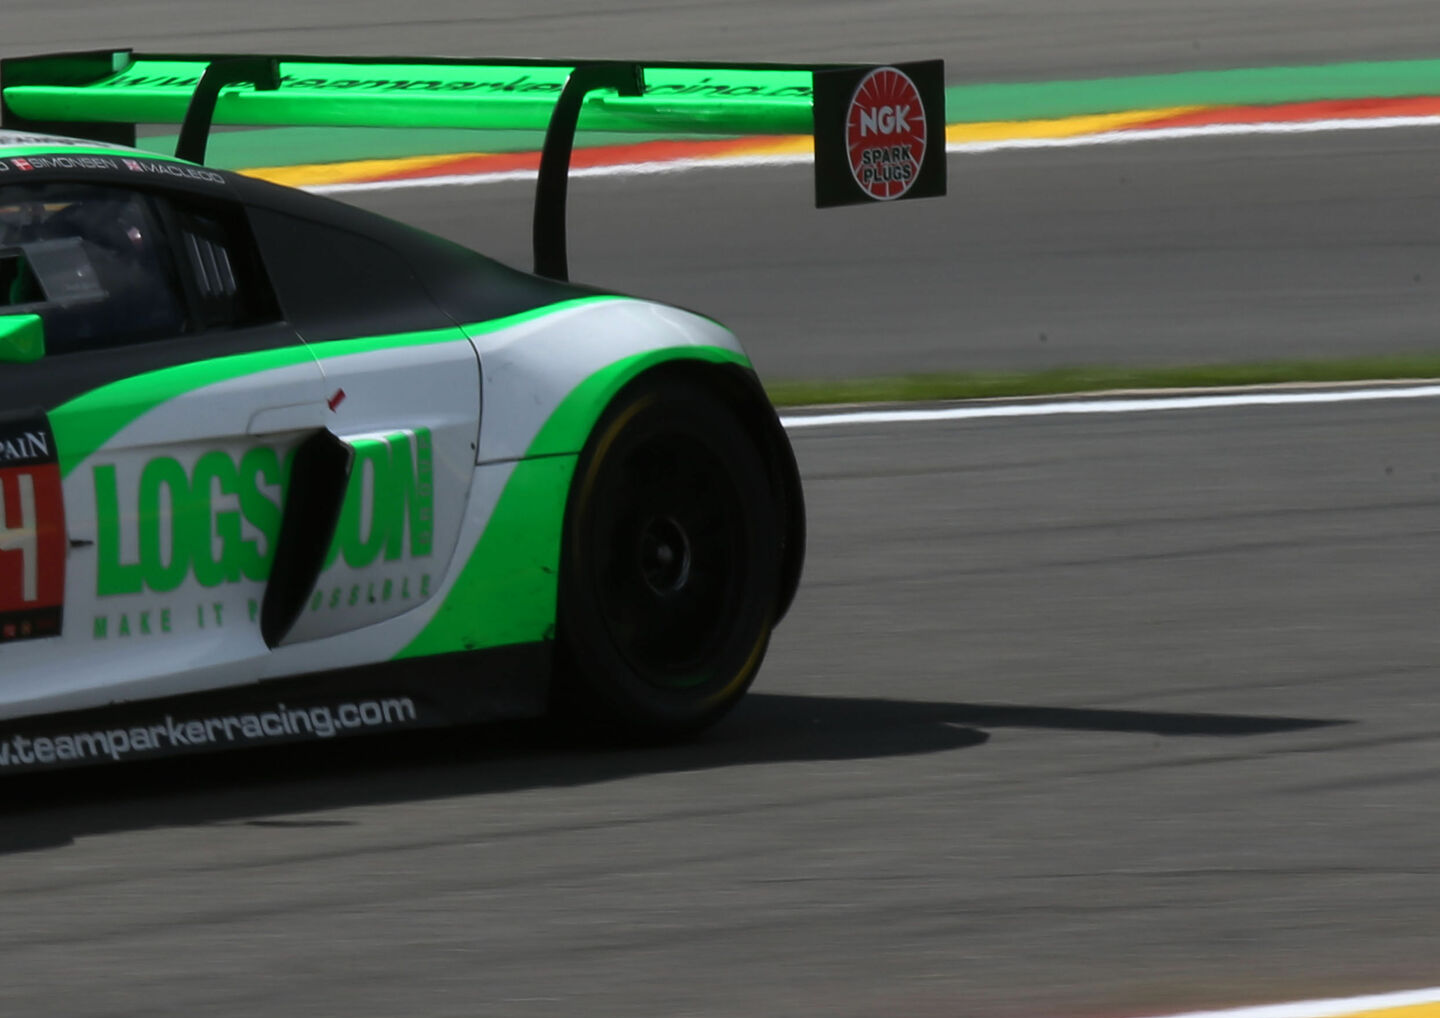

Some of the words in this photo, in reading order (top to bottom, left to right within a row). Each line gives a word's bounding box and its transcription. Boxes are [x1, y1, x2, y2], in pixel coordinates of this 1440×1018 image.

[860, 104, 911, 137] NGK
[26, 156, 118, 171] SIMONSEN
[862, 145, 912, 165] SPARK
[140, 160, 226, 185] MACLEOD
[863, 164, 912, 185] PLUGS
[93, 608, 173, 640] MAKE
[197, 602, 224, 630] IT
